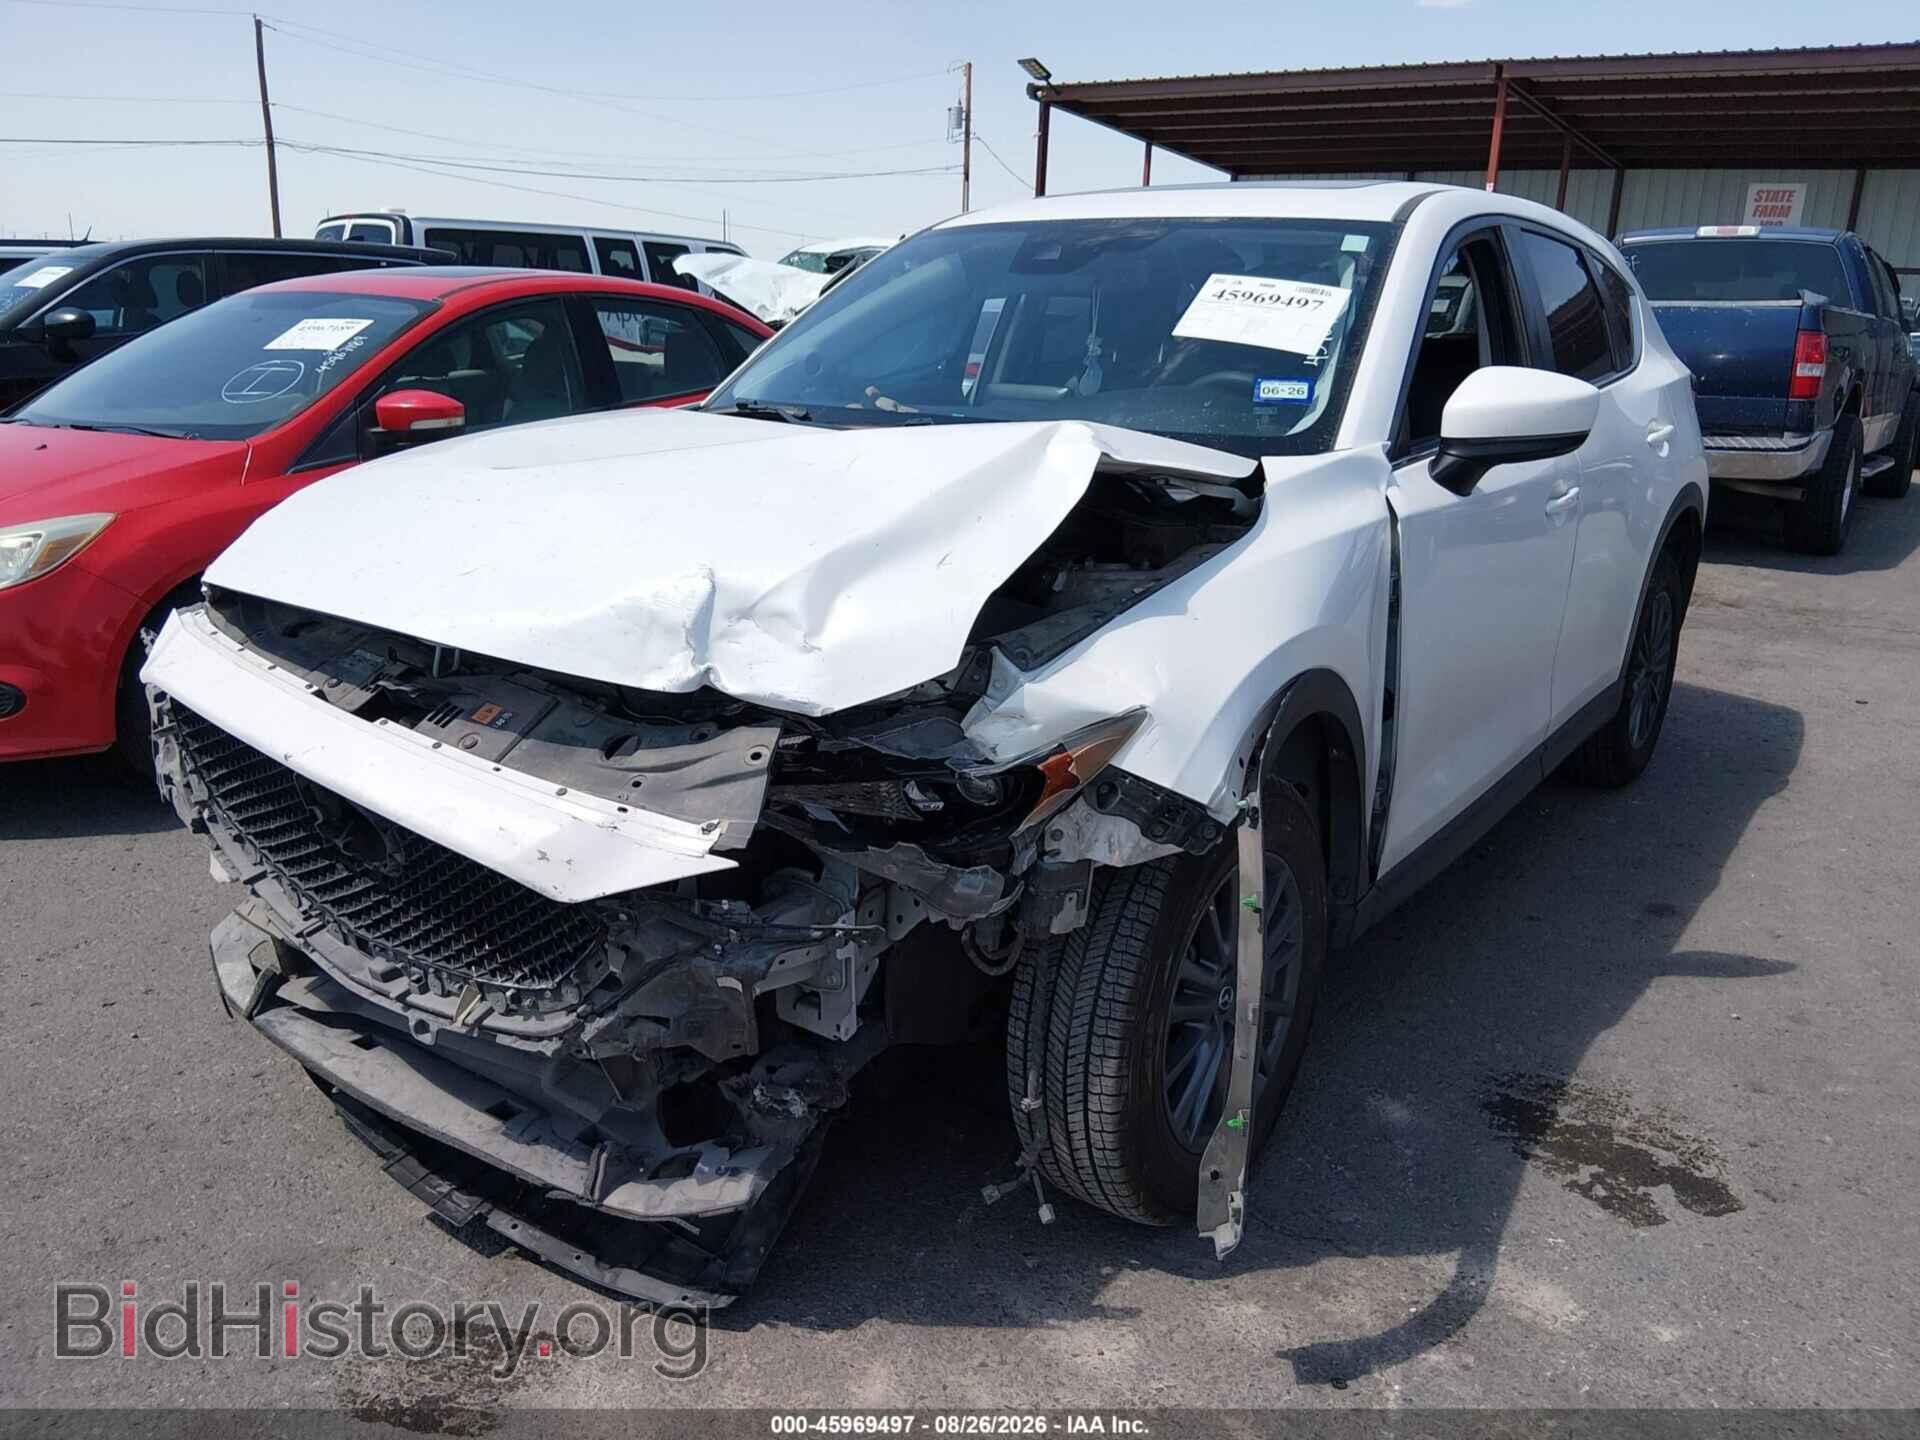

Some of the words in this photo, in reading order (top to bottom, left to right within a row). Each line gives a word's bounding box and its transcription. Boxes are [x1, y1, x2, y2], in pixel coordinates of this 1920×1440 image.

[1754, 189, 1796, 203] STATE
[1752, 204, 1792, 218] FARM
[1212, 289, 1325, 310] 45969497
[1261, 386, 1306, 396] 06-26
